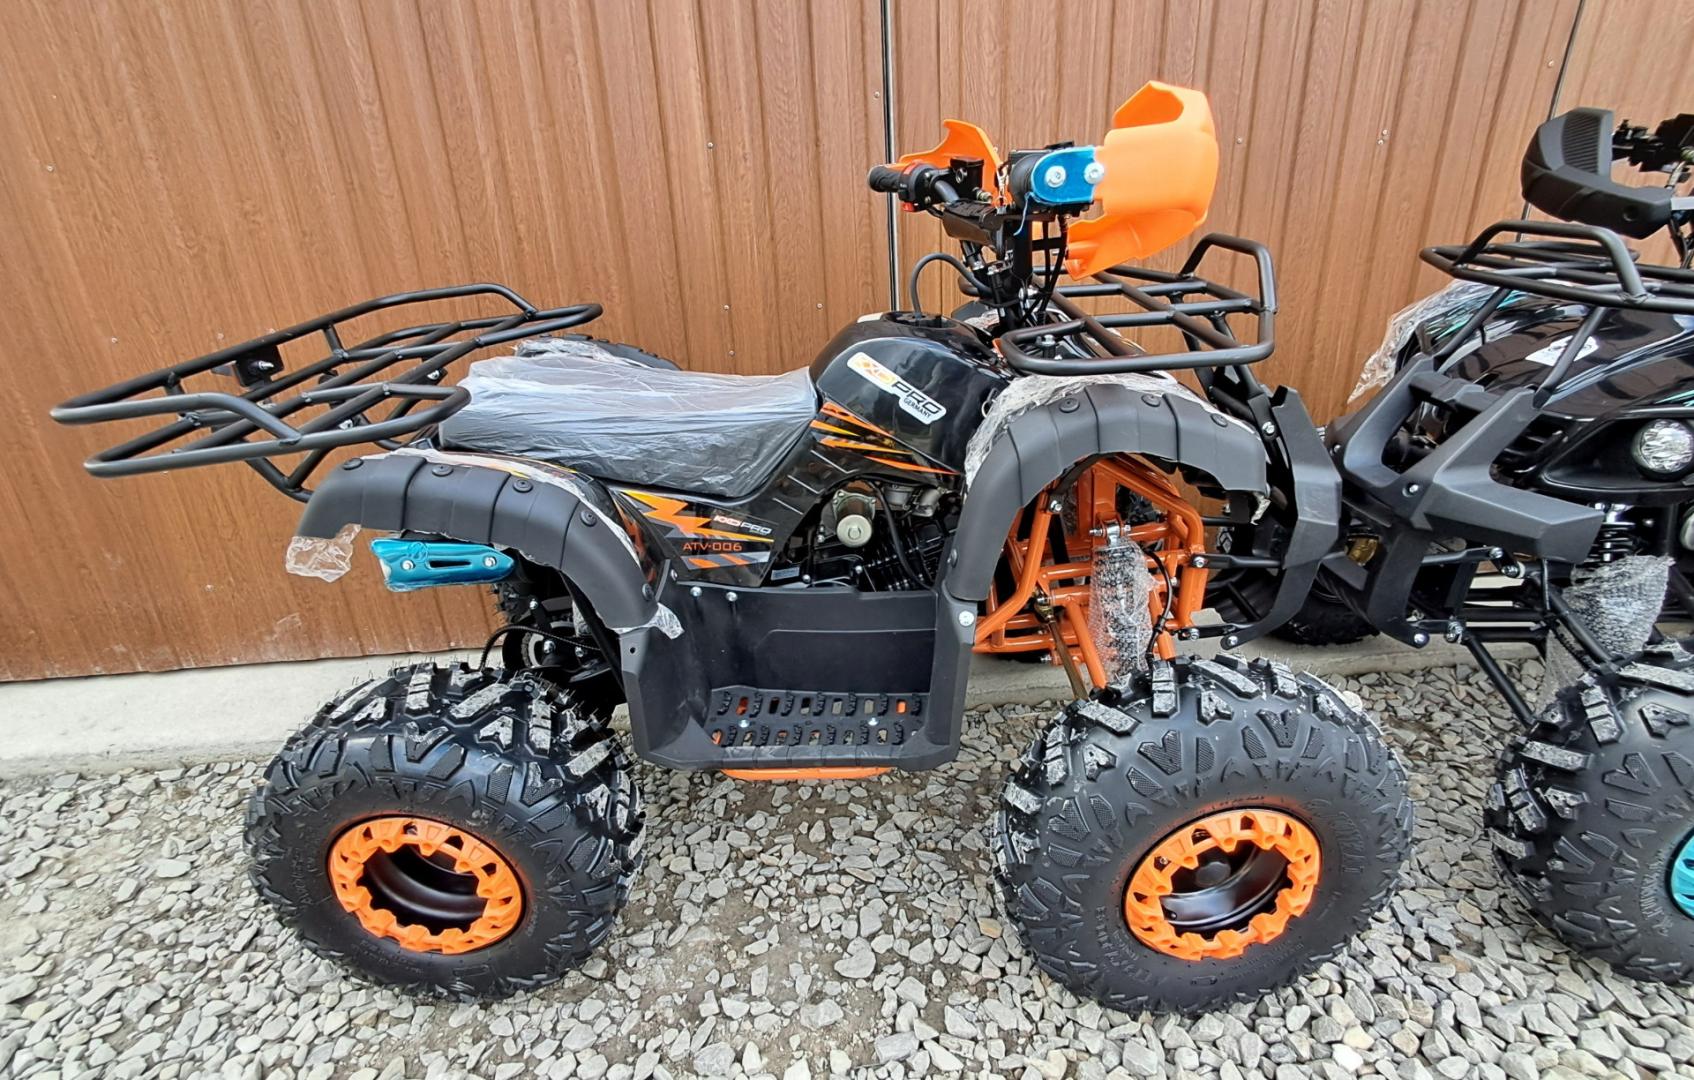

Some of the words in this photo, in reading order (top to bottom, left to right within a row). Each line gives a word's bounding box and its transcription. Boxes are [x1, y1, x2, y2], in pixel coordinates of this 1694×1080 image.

[891, 380, 943, 414] PRO
[903, 397, 932, 418] GERMANY
[682, 542, 743, 552] ATV-006
